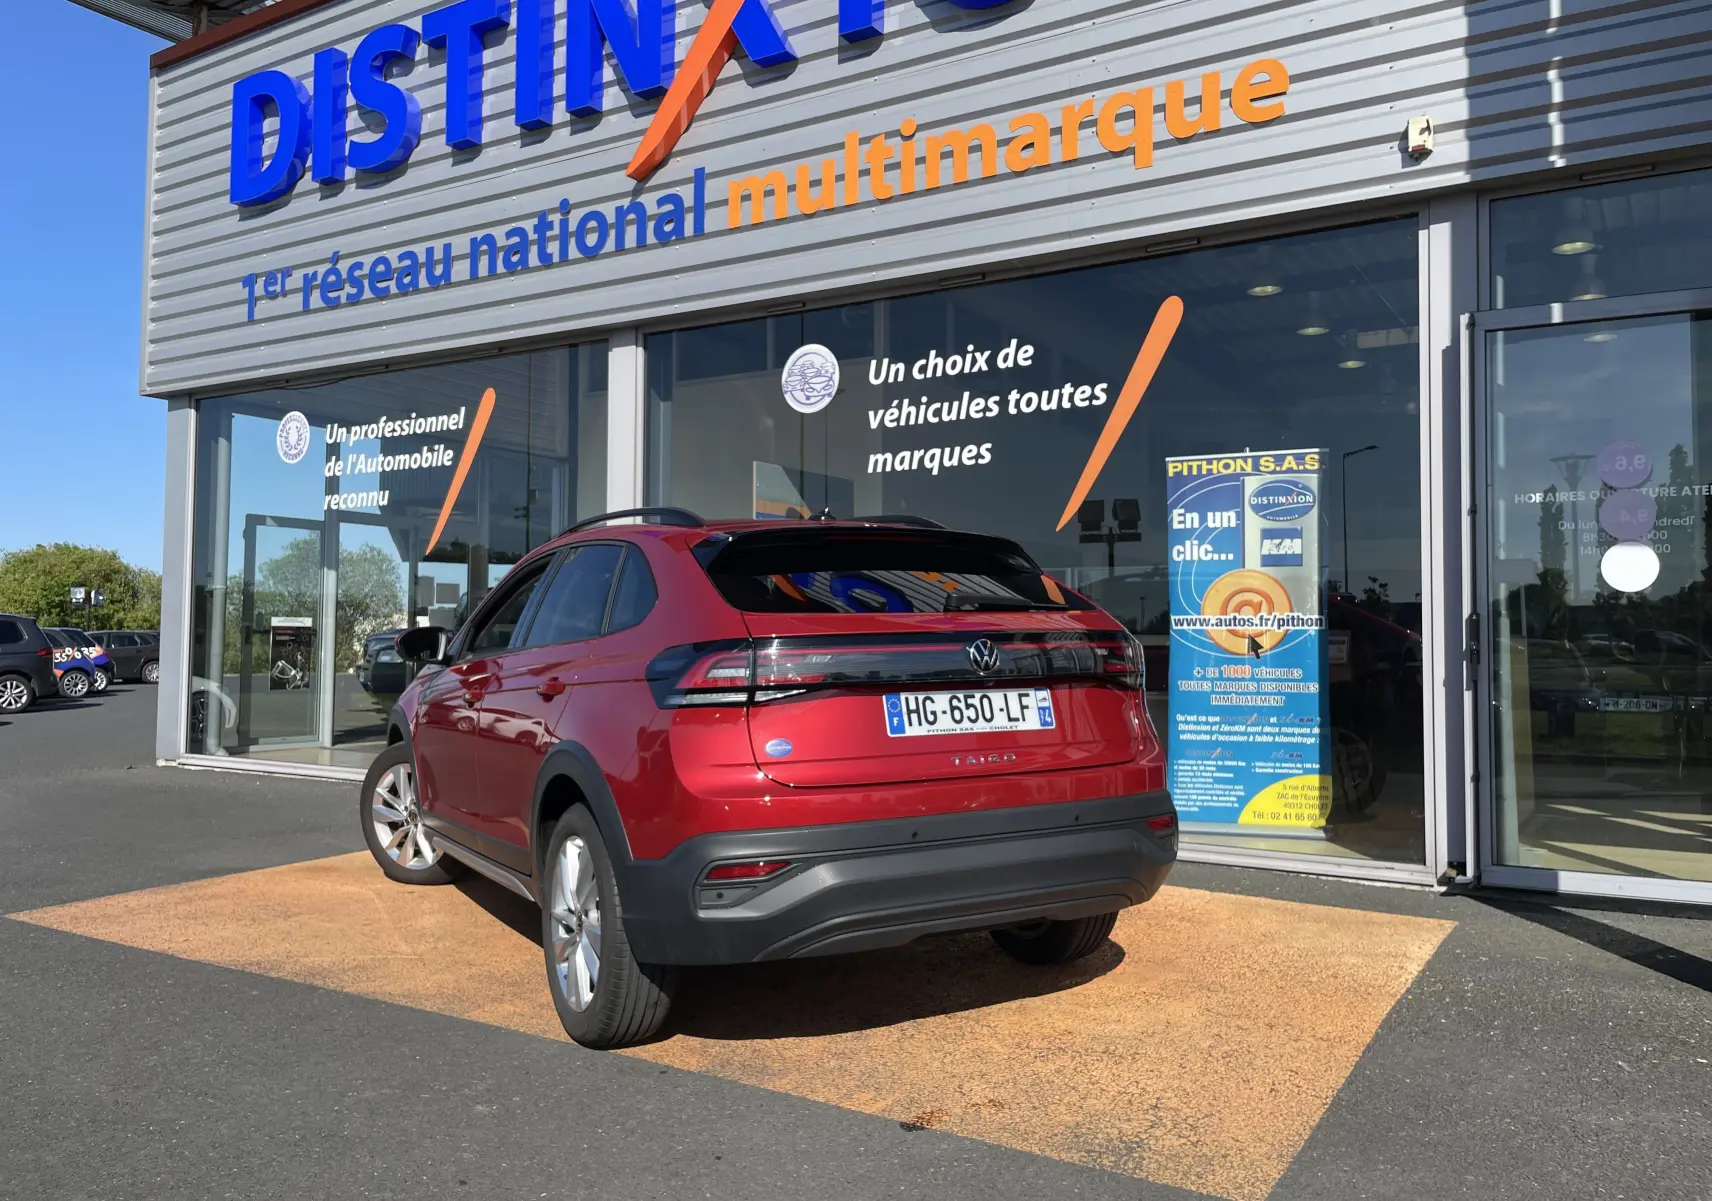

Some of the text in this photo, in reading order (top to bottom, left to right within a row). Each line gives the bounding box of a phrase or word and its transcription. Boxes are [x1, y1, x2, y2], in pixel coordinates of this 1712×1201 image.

[241, 57, 1291, 321] 1er réseau national multimarque
[868, 338, 1035, 385] Un choix de
[867, 382, 1108, 429] véhicules toutes
[325, 406, 466, 446] Un professionnel
[324, 444, 454, 477] de l'Automobile
[866, 442, 993, 475] marques
[1168, 458, 1252, 477] PITHON
[323, 489, 390, 510] reconnu
[1250, 491, 1314, 506] DISTINXION
[1514, 490, 1586, 504] HORAIRES
[1172, 508, 1236, 530] En un
[1558, 520, 1575, 530] Du
[1172, 539, 1234, 561] clic...
[1172, 614, 1324, 630] www.autos.fr/pithon
[1206, 667, 1219, 678] DE
[1221, 665, 1251, 678] 1000
[1254, 666, 1302, 679] VÉHICULES
[1178, 681, 1319, 692] TOUTES MARQUES DISPONIBLES
[1211, 693, 1285, 705] IMMÉDIATEMENT
[905, 692, 1031, 727] HG-650-LF
[893, 717, 899, 727] F
[1176, 714, 1197, 722] Qu'est
[1207, 715, 1221, 723] que
[1178, 723, 1211, 731] Distinxion
[1262, 725, 1280, 733] deux
[1280, 726, 1311, 735] marques
[1179, 733, 1211, 741] véhicules
[1254, 734, 1274, 742] faible
[951, 752, 1017, 766] TAIGO
[1270, 811, 1281, 820] 02
[1283, 812, 1292, 820] 41
